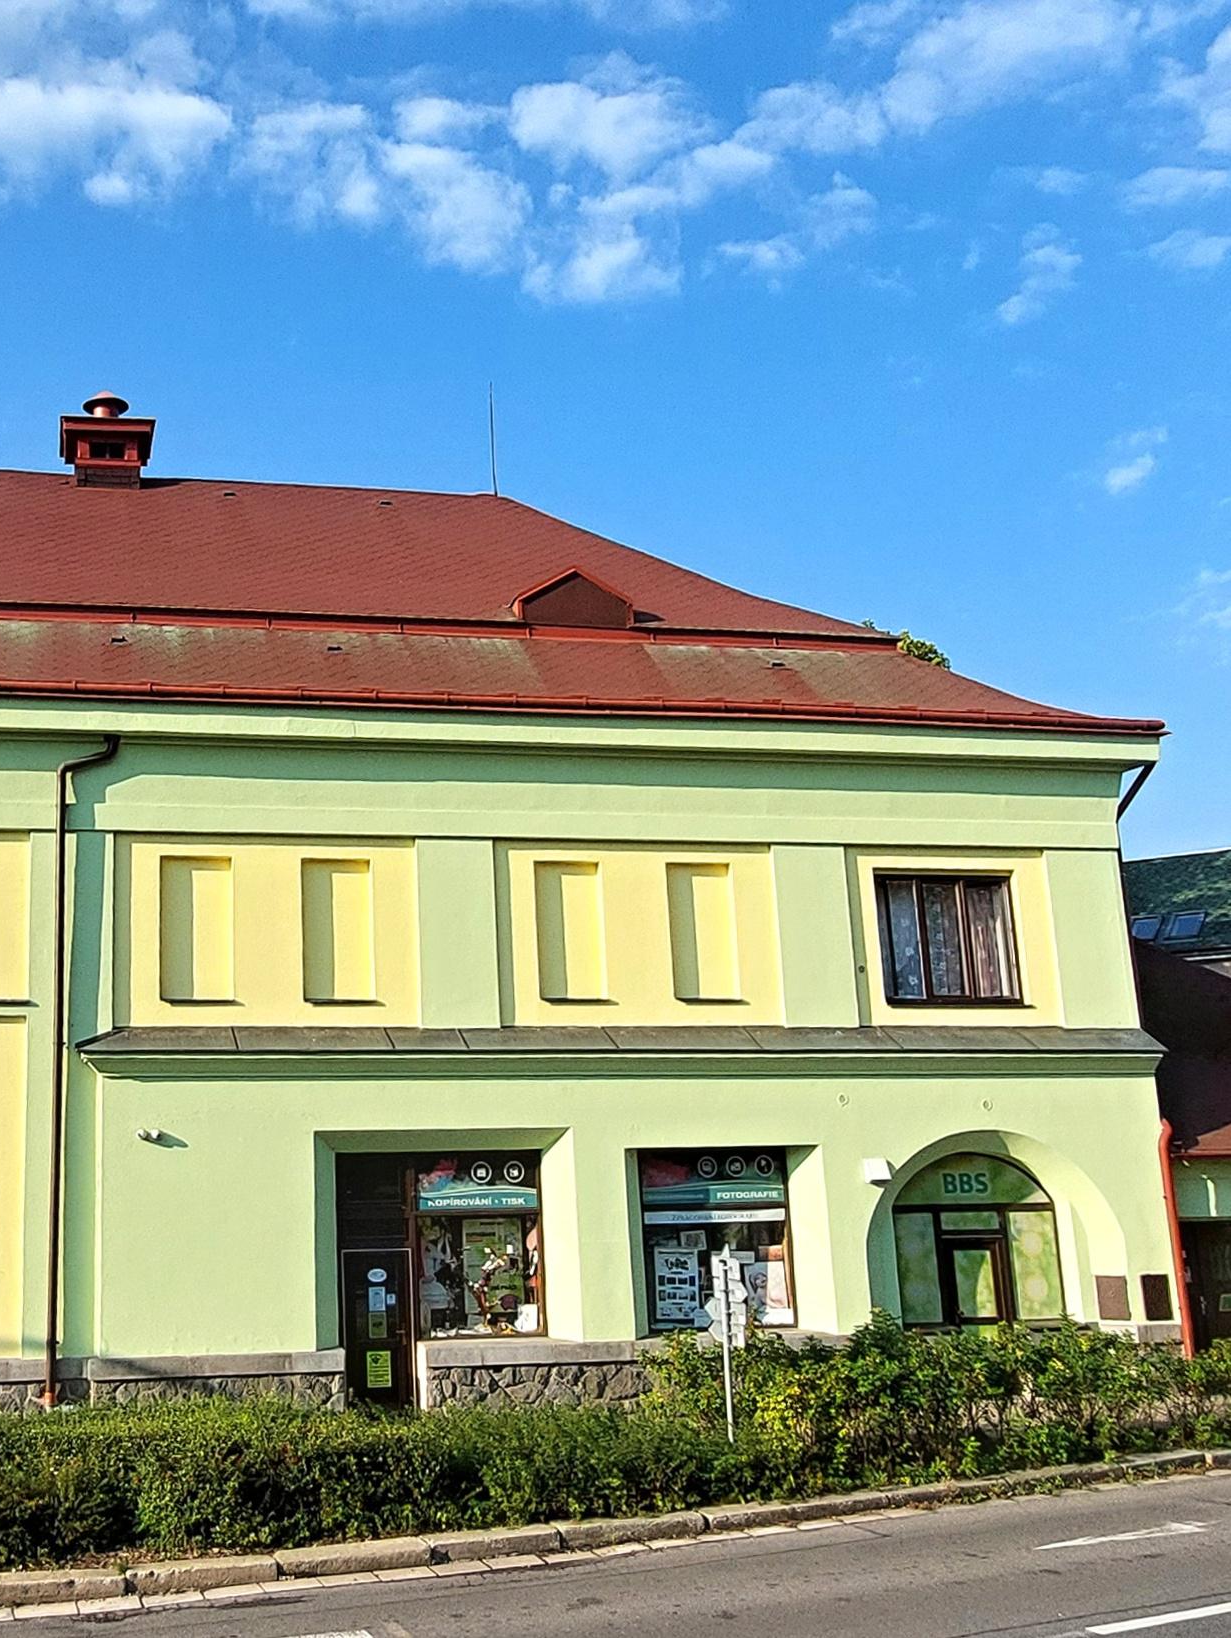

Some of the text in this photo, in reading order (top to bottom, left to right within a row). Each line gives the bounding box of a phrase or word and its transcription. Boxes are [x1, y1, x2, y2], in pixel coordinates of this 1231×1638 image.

[942, 1172, 988, 1194] BBS
[716, 1190, 779, 1200] FOTOGRAFIE
[501, 1197, 525, 1206] TISK
